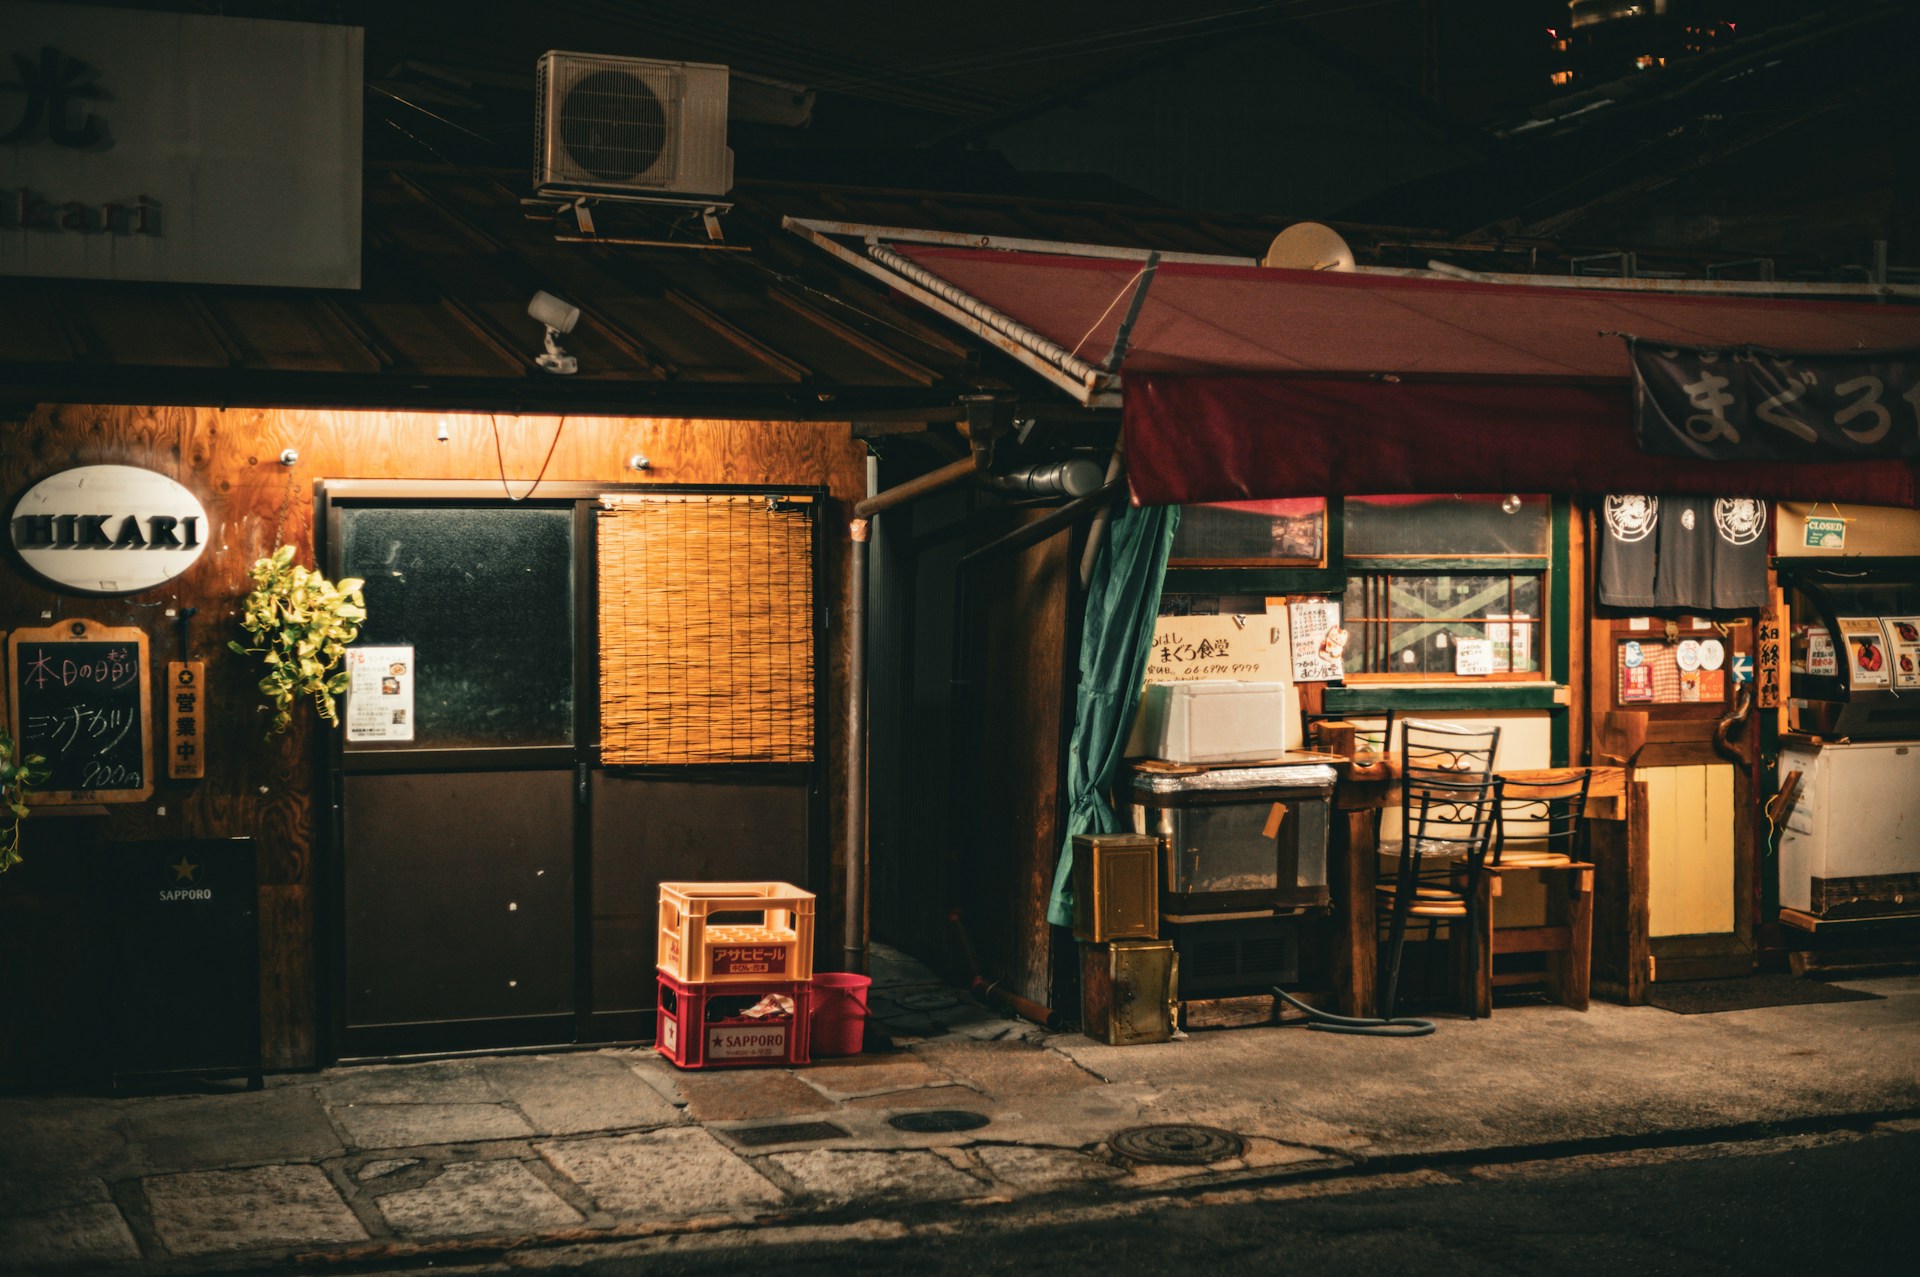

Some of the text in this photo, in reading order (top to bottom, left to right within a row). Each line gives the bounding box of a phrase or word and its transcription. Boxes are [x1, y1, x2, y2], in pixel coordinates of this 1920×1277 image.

[0, 46, 115, 151] 光
[0, 187, 160, 237] kari
[1683, 368, 1920, 444] まぐろ
[13, 513, 200, 551] HIKARI
[1808, 521, 1843, 531] CLOSED
[1161, 638, 1230, 663] まぐろ食堂
[176, 692, 196, 761] 営業中
[159, 888, 212, 901] SAPPORO
[714, 947, 785, 961] アサヒビール
[725, 1035, 783, 1048] SAPPORO
